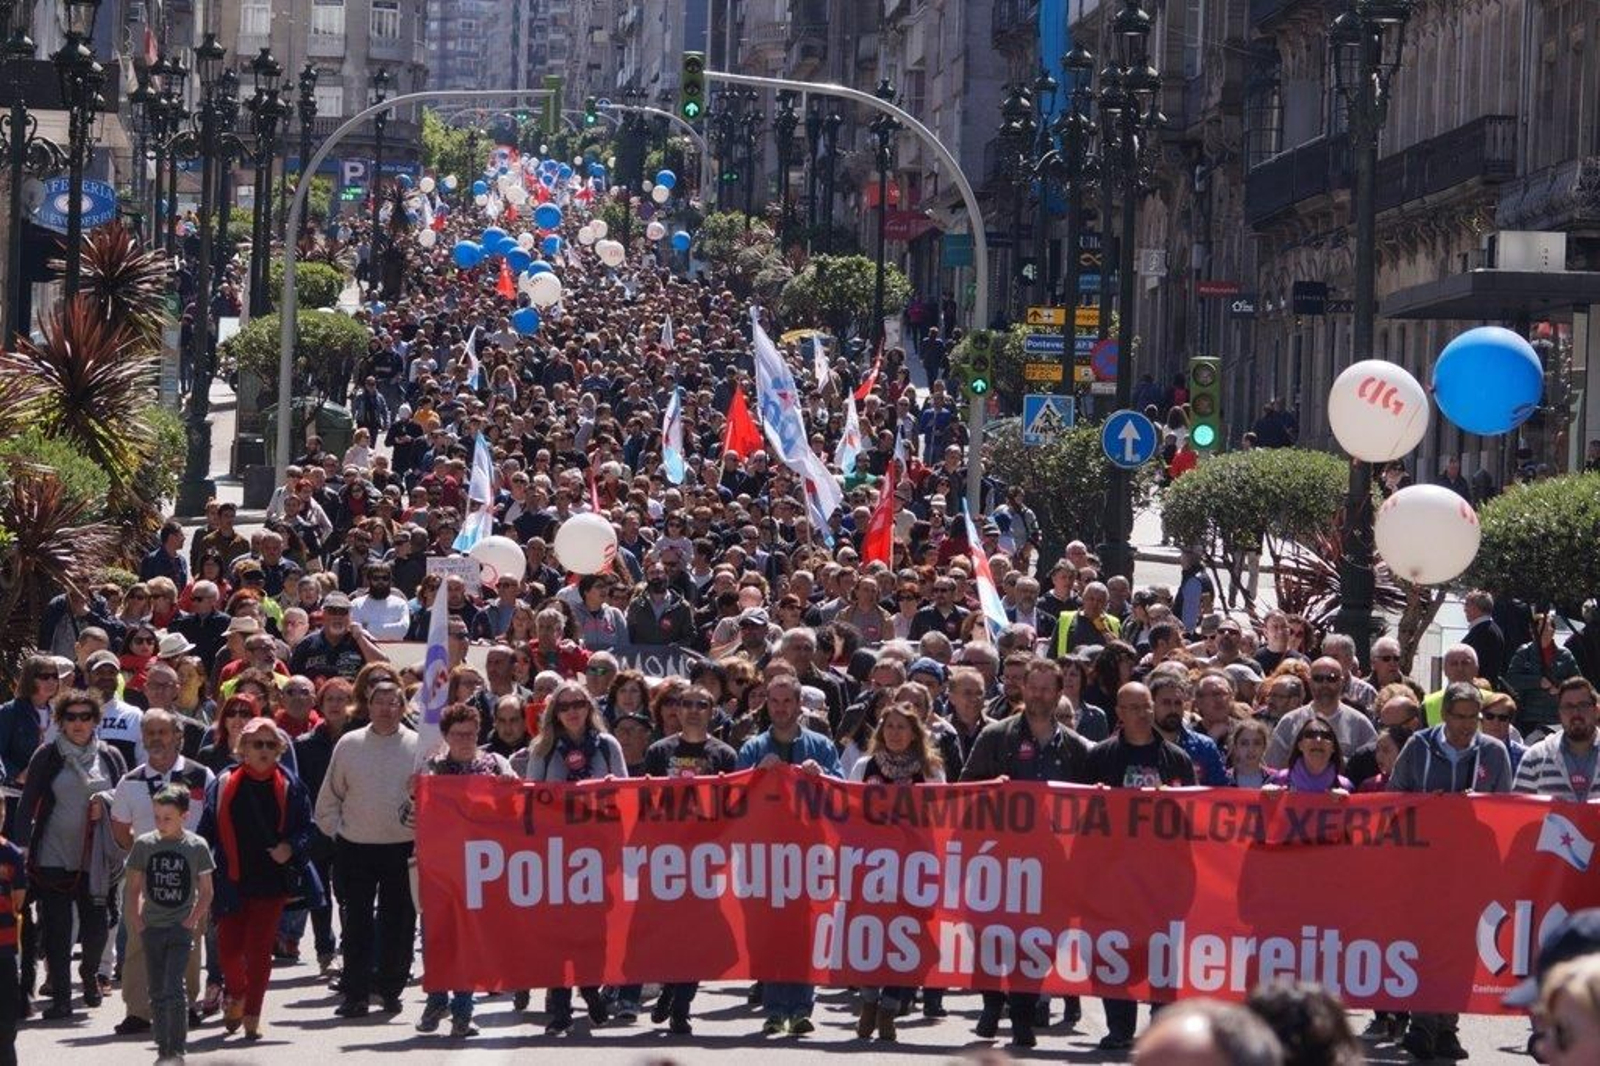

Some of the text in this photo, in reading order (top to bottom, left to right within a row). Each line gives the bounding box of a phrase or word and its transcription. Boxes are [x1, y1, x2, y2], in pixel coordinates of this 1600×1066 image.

[344, 161, 365, 185] P
[1357, 375, 1405, 416] CIG
[564, 788, 621, 824] DE
[795, 778, 851, 822] NO
[1051, 791, 1112, 835] DA
[1127, 795, 1267, 848] FOLGA
[1283, 802, 1430, 848] XERAL
[152, 887, 182, 901] TOWN
[154, 871, 181, 887] THIS
[464, 836, 1043, 914] Pola recuperación
[812, 902, 1419, 998] dos nosos dereitos
